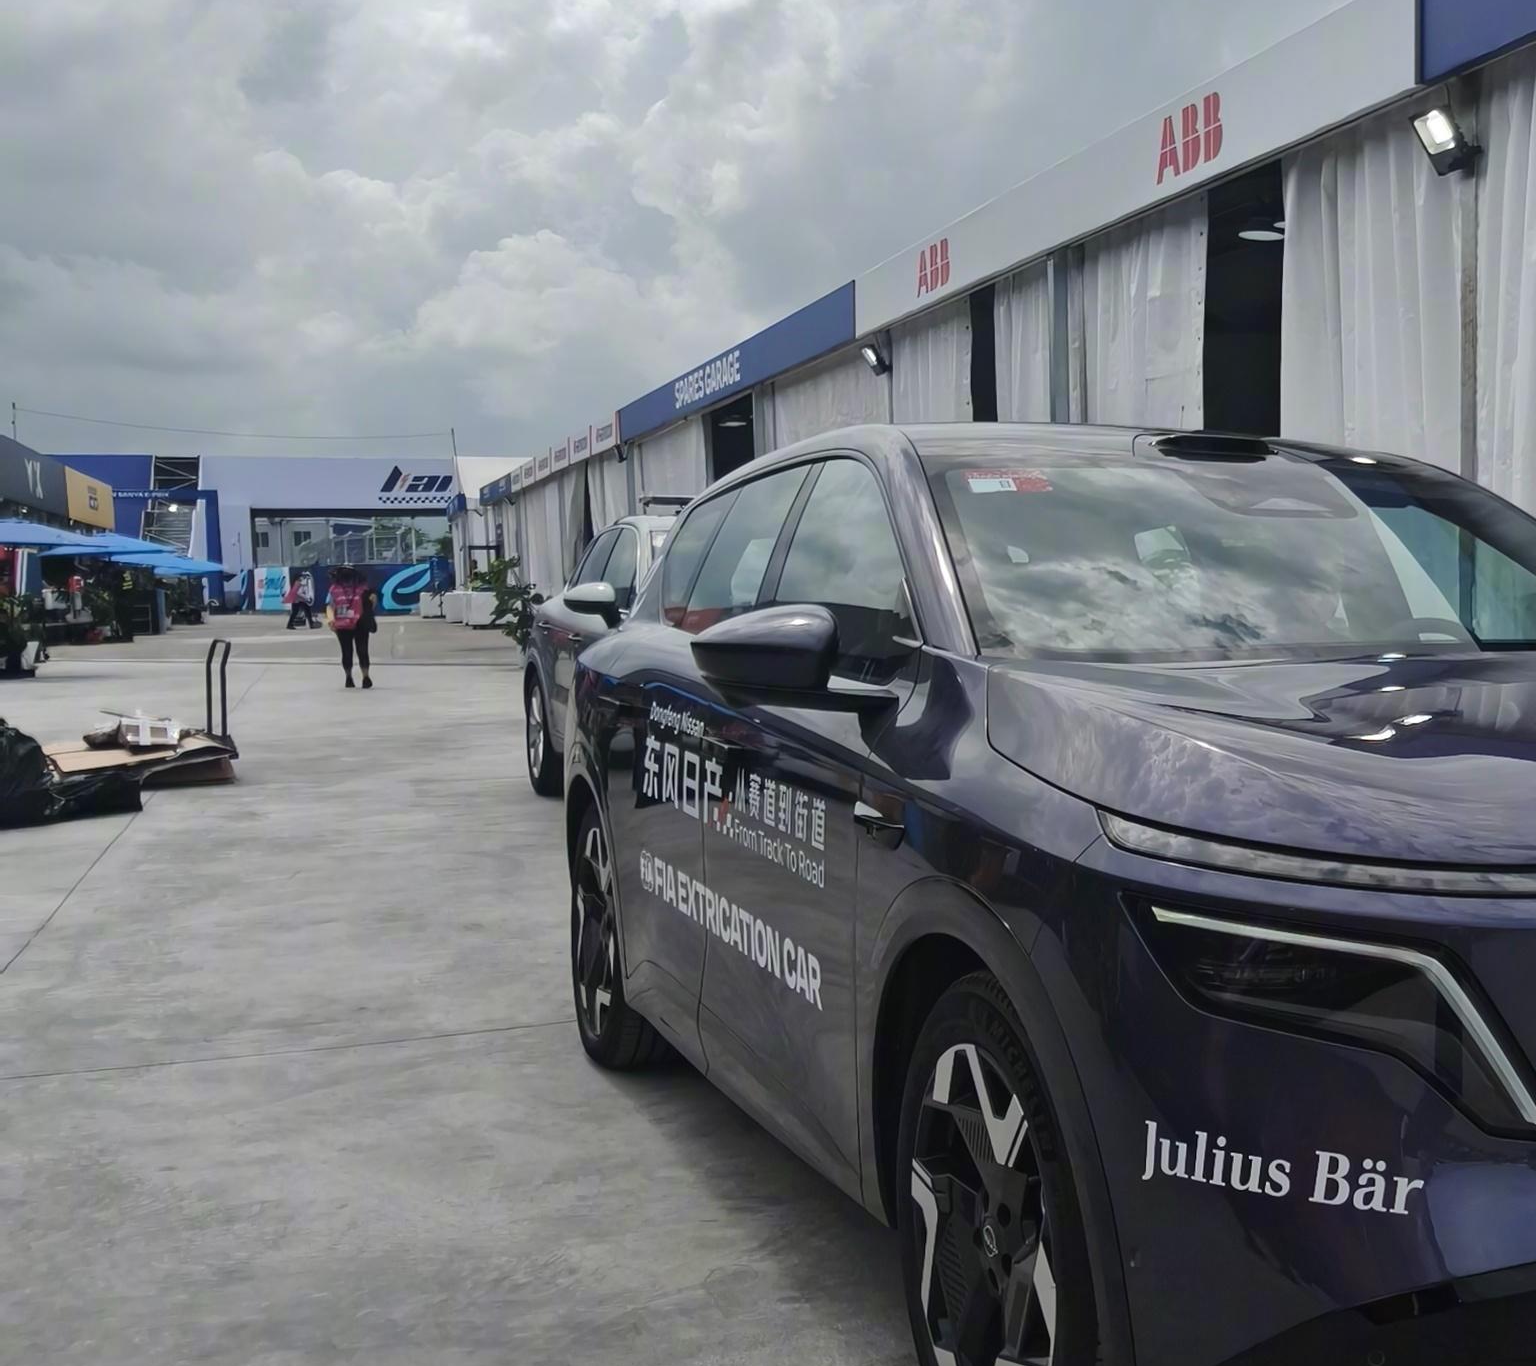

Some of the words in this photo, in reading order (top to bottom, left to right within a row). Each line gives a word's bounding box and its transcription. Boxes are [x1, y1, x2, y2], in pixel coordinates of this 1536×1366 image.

[1156, 92, 1223, 185] ABB
[917, 238, 950, 298] ABB
[674, 368, 704, 410] SPARES
[704, 349, 741, 395] GARAGE
[649, 700, 681, 735] Dongfeng
[680, 711, 704, 738] Nissan
[643, 735, 723, 824] 东风日产
[734, 766, 826, 851] 从赛道到街道
[734, 818, 758, 852] From
[758, 830, 784, 868] Track
[784, 842, 797, 873] To
[798, 850, 824, 889] Road
[654, 856, 677, 908] FIA
[677, 870, 781, 980] EXTRICATION
[783, 937, 823, 1012] CAR
[1141, 1119, 1292, 1198] Julius
[1308, 1149, 1425, 1216] Bär
